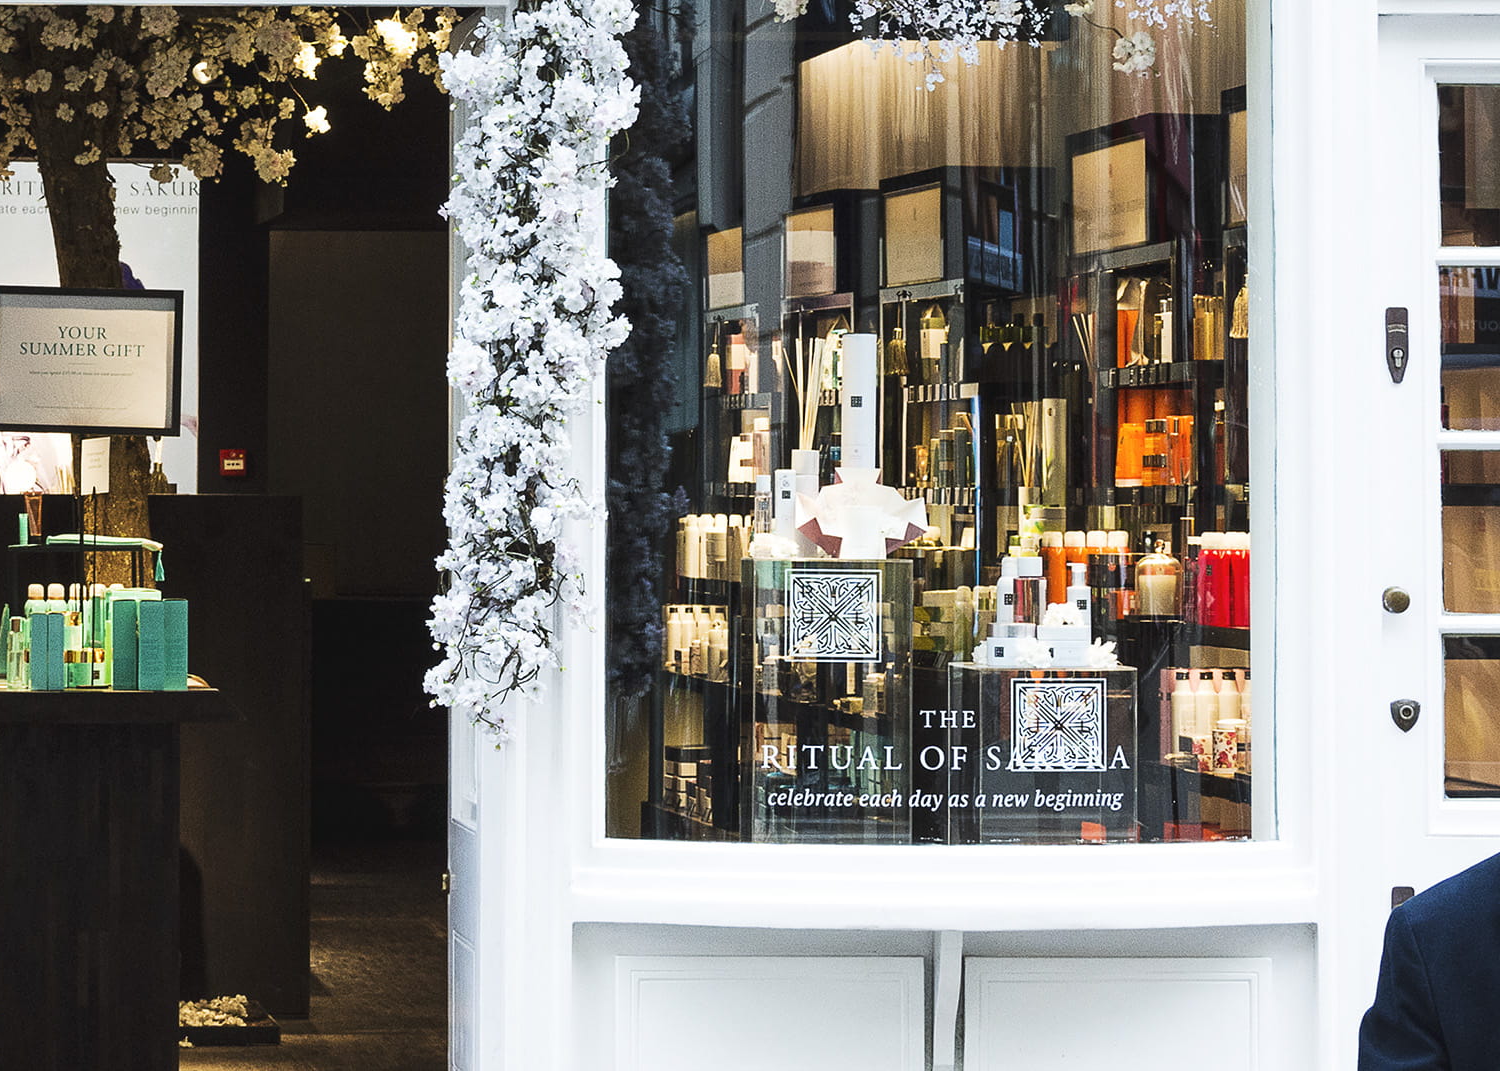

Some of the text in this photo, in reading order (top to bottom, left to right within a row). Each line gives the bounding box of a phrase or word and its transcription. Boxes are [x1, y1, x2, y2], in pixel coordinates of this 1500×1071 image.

[58, 326, 107, 340] YOUR
[19, 342, 145, 358] SUMMER GIFT
[919, 709, 976, 729] THE
[760, 744, 903, 770] RITUAL
[919, 745, 968, 771] OF
[767, 787, 1125, 812] celebrate each day as a new beginning
